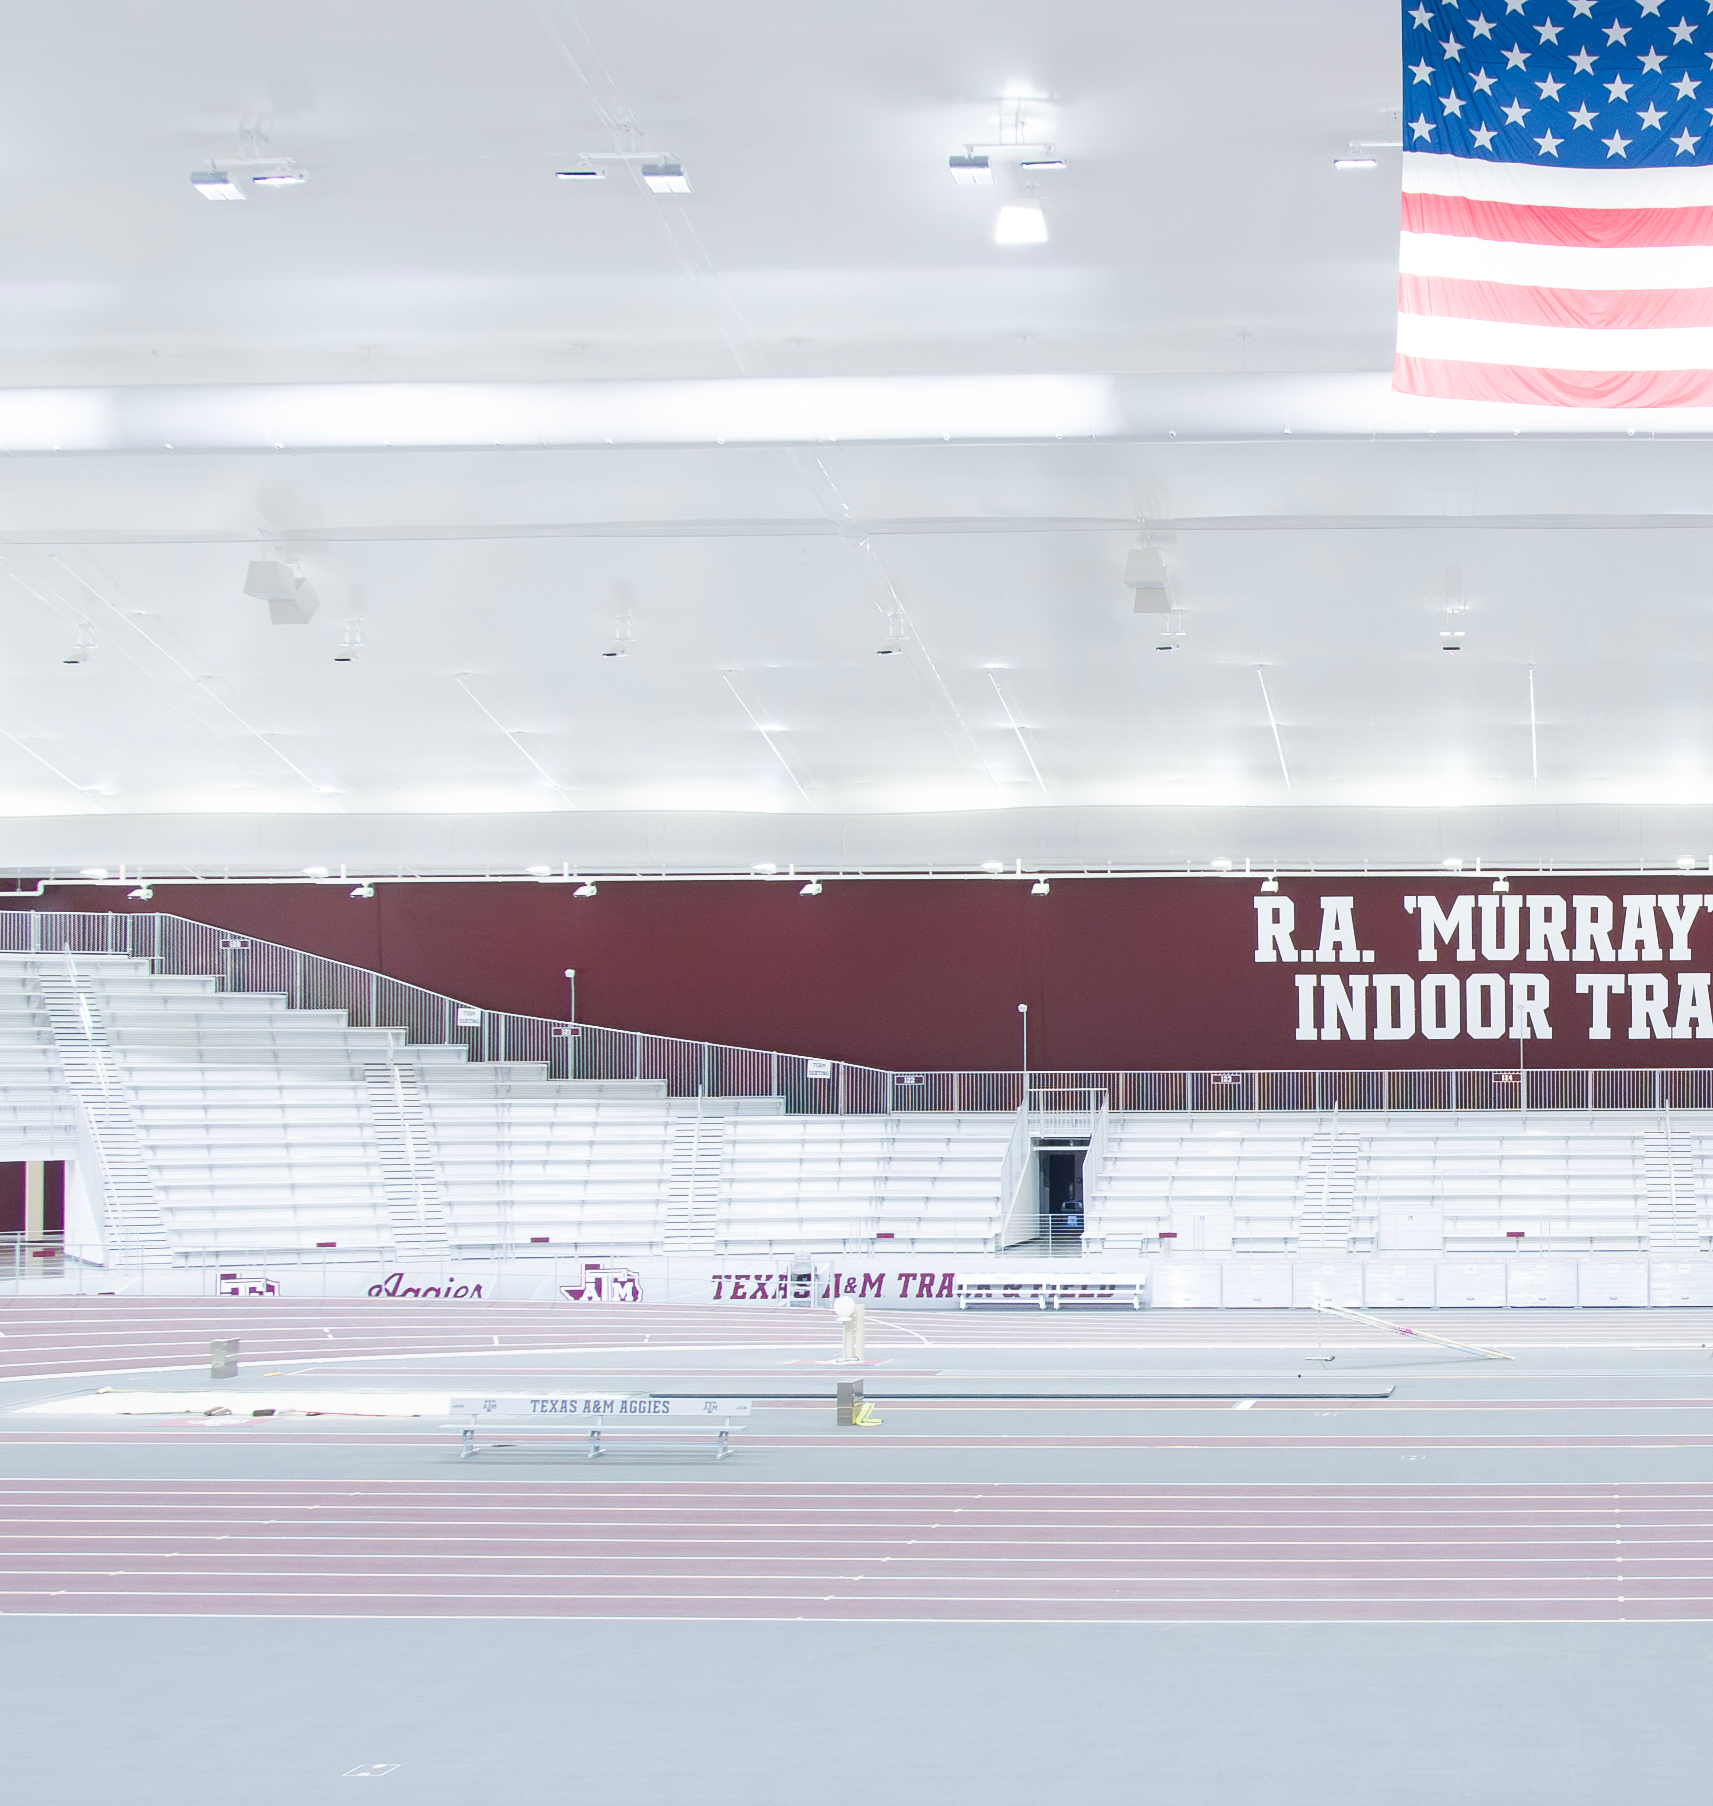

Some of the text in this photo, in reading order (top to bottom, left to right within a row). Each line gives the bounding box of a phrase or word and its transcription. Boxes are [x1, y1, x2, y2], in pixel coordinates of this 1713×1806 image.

[1254, 896, 1374, 963] R.A.
[1295, 973, 1552, 1041] INDOOR
[530, 1399, 578, 1413] TEXAS
[582, 1399, 614, 1414] A&M
[619, 1400, 671, 1414] AGGIES
